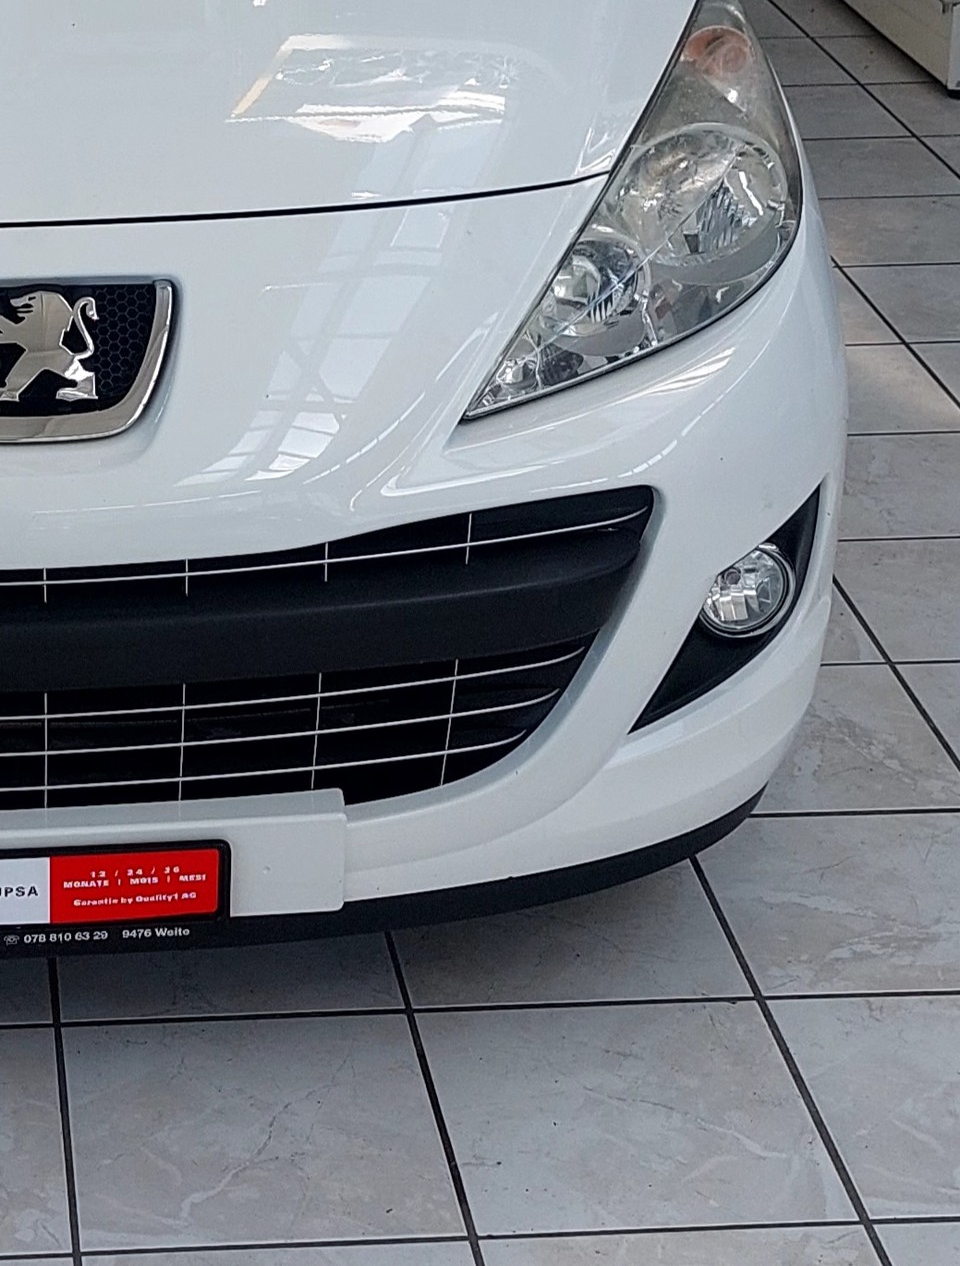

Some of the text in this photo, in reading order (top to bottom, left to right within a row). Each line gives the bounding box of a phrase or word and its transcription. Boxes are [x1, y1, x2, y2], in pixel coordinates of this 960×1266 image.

[63, 879, 110, 889] MONATE
[23, 933, 47, 944] 078
[49, 932, 72, 943] 810
[74, 931, 91, 941] 63
[121, 927, 152, 939] 9476
